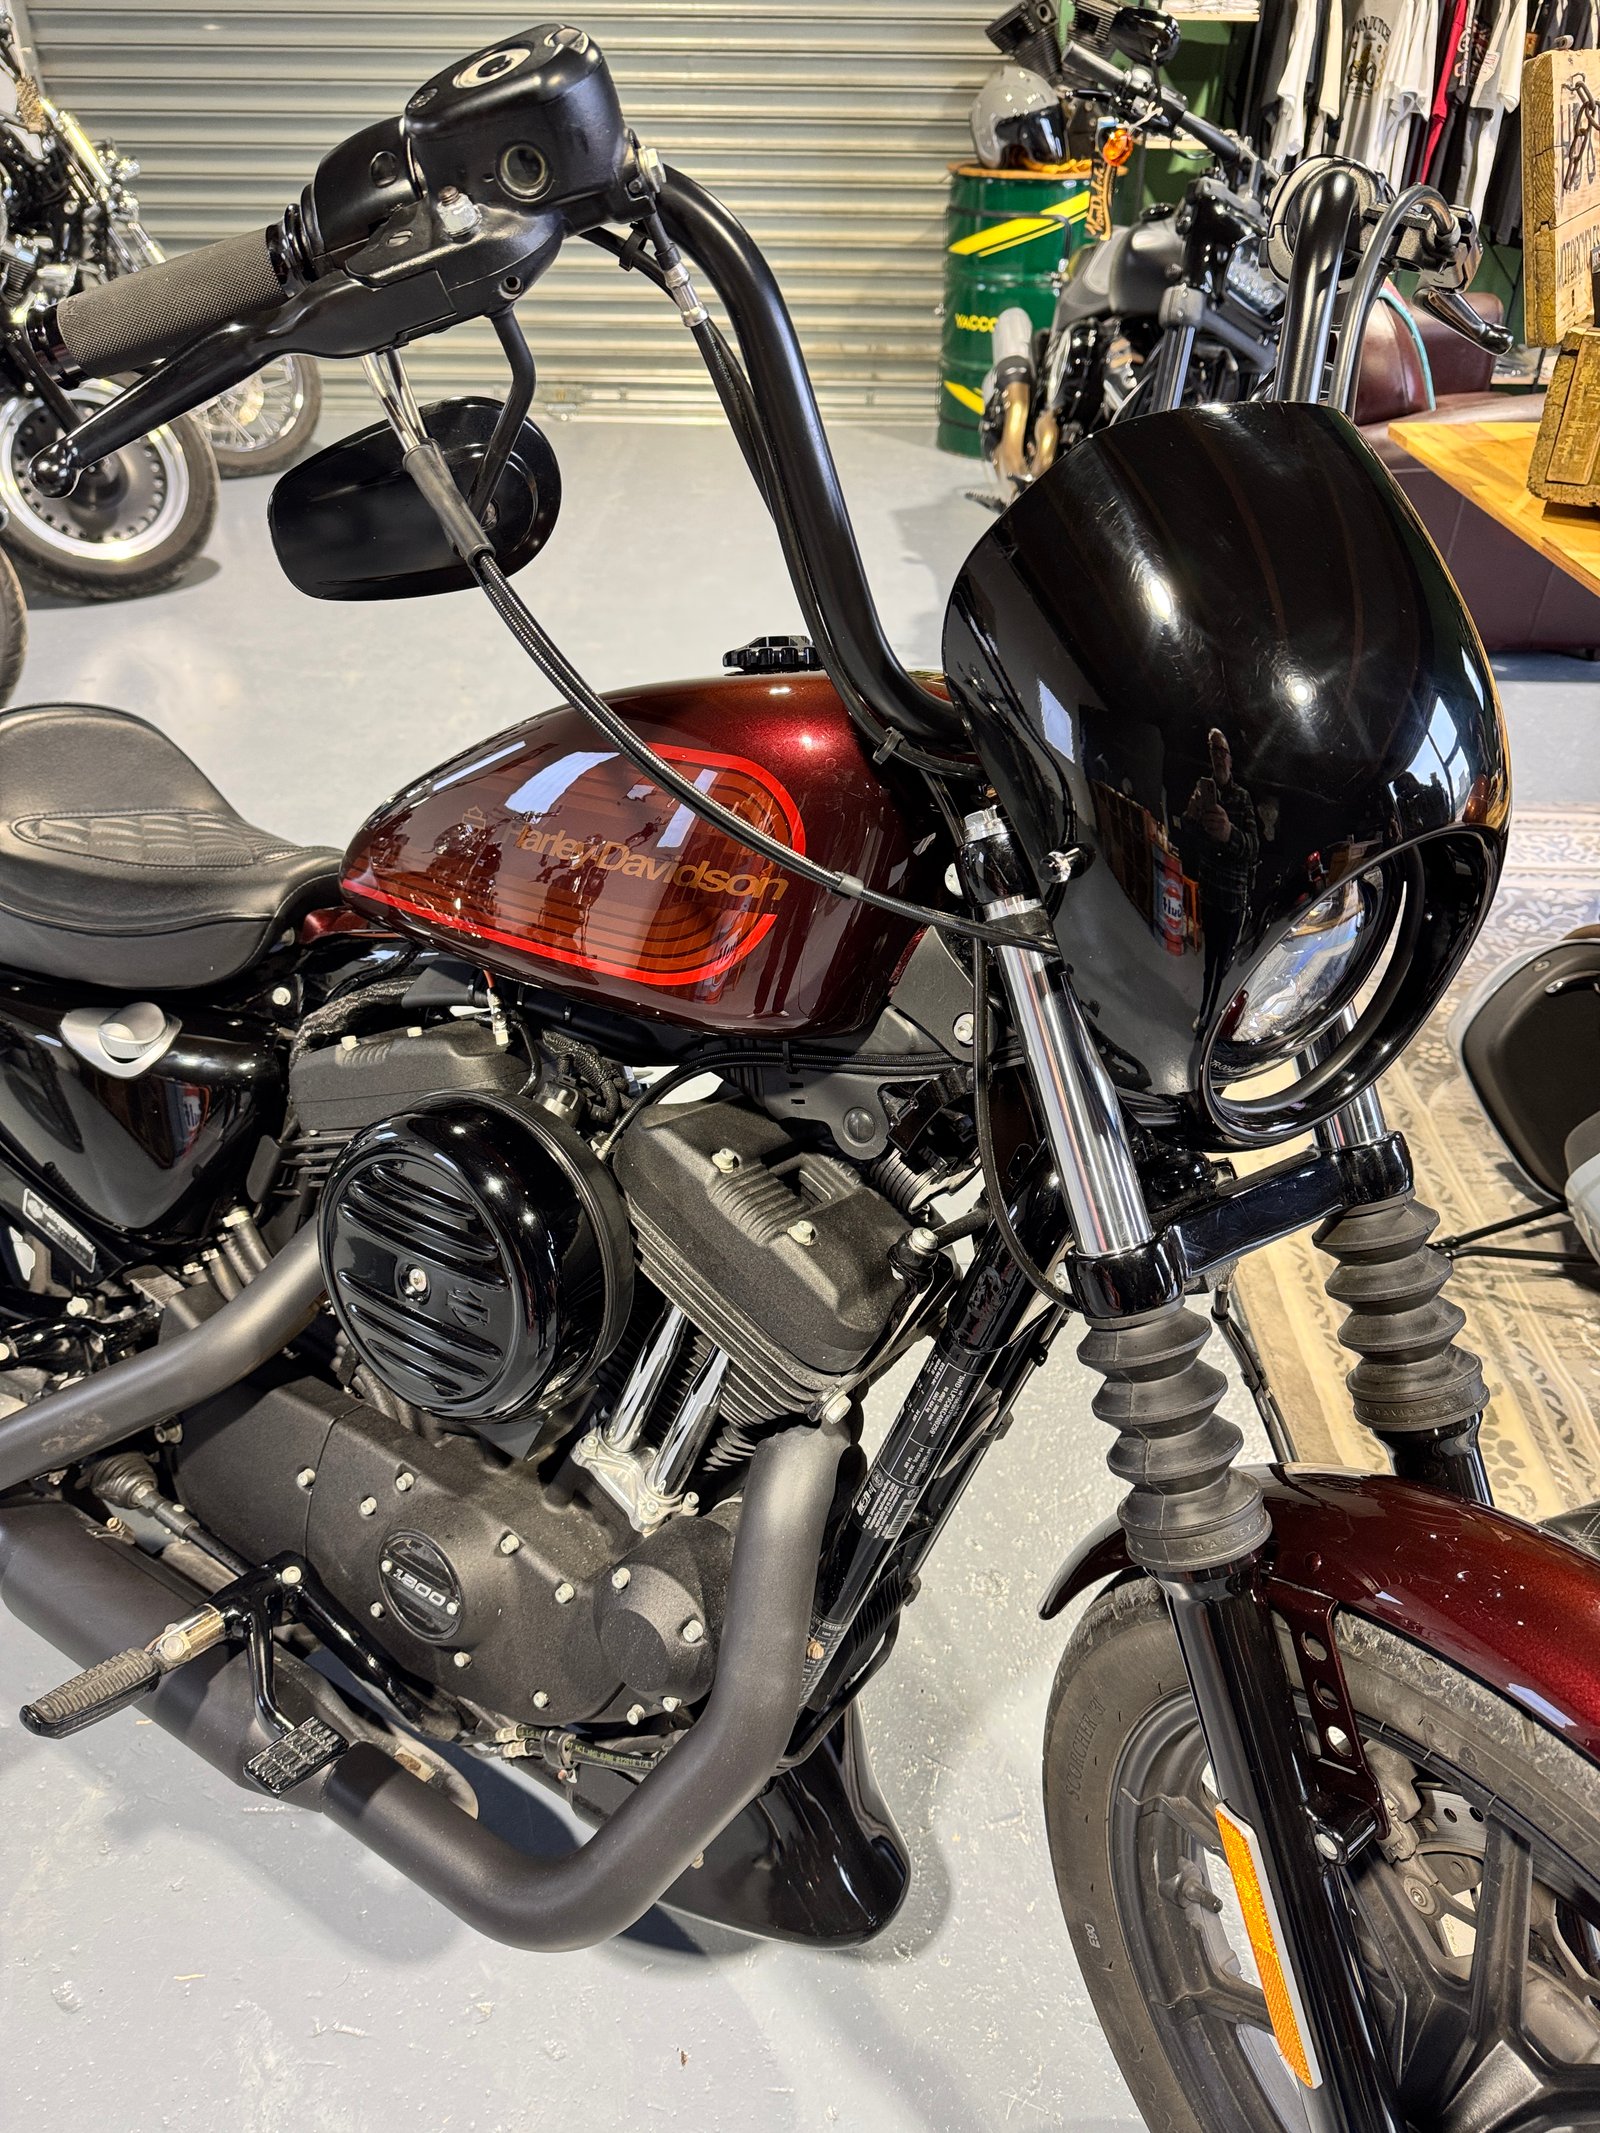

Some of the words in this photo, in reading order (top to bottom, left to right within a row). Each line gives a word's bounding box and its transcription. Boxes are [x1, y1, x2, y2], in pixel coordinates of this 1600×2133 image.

[505, 822, 789, 900] Harley-Davidson
[393, 1568, 447, 1607] 1200
[1065, 1713, 1098, 1801] SCORCHER
